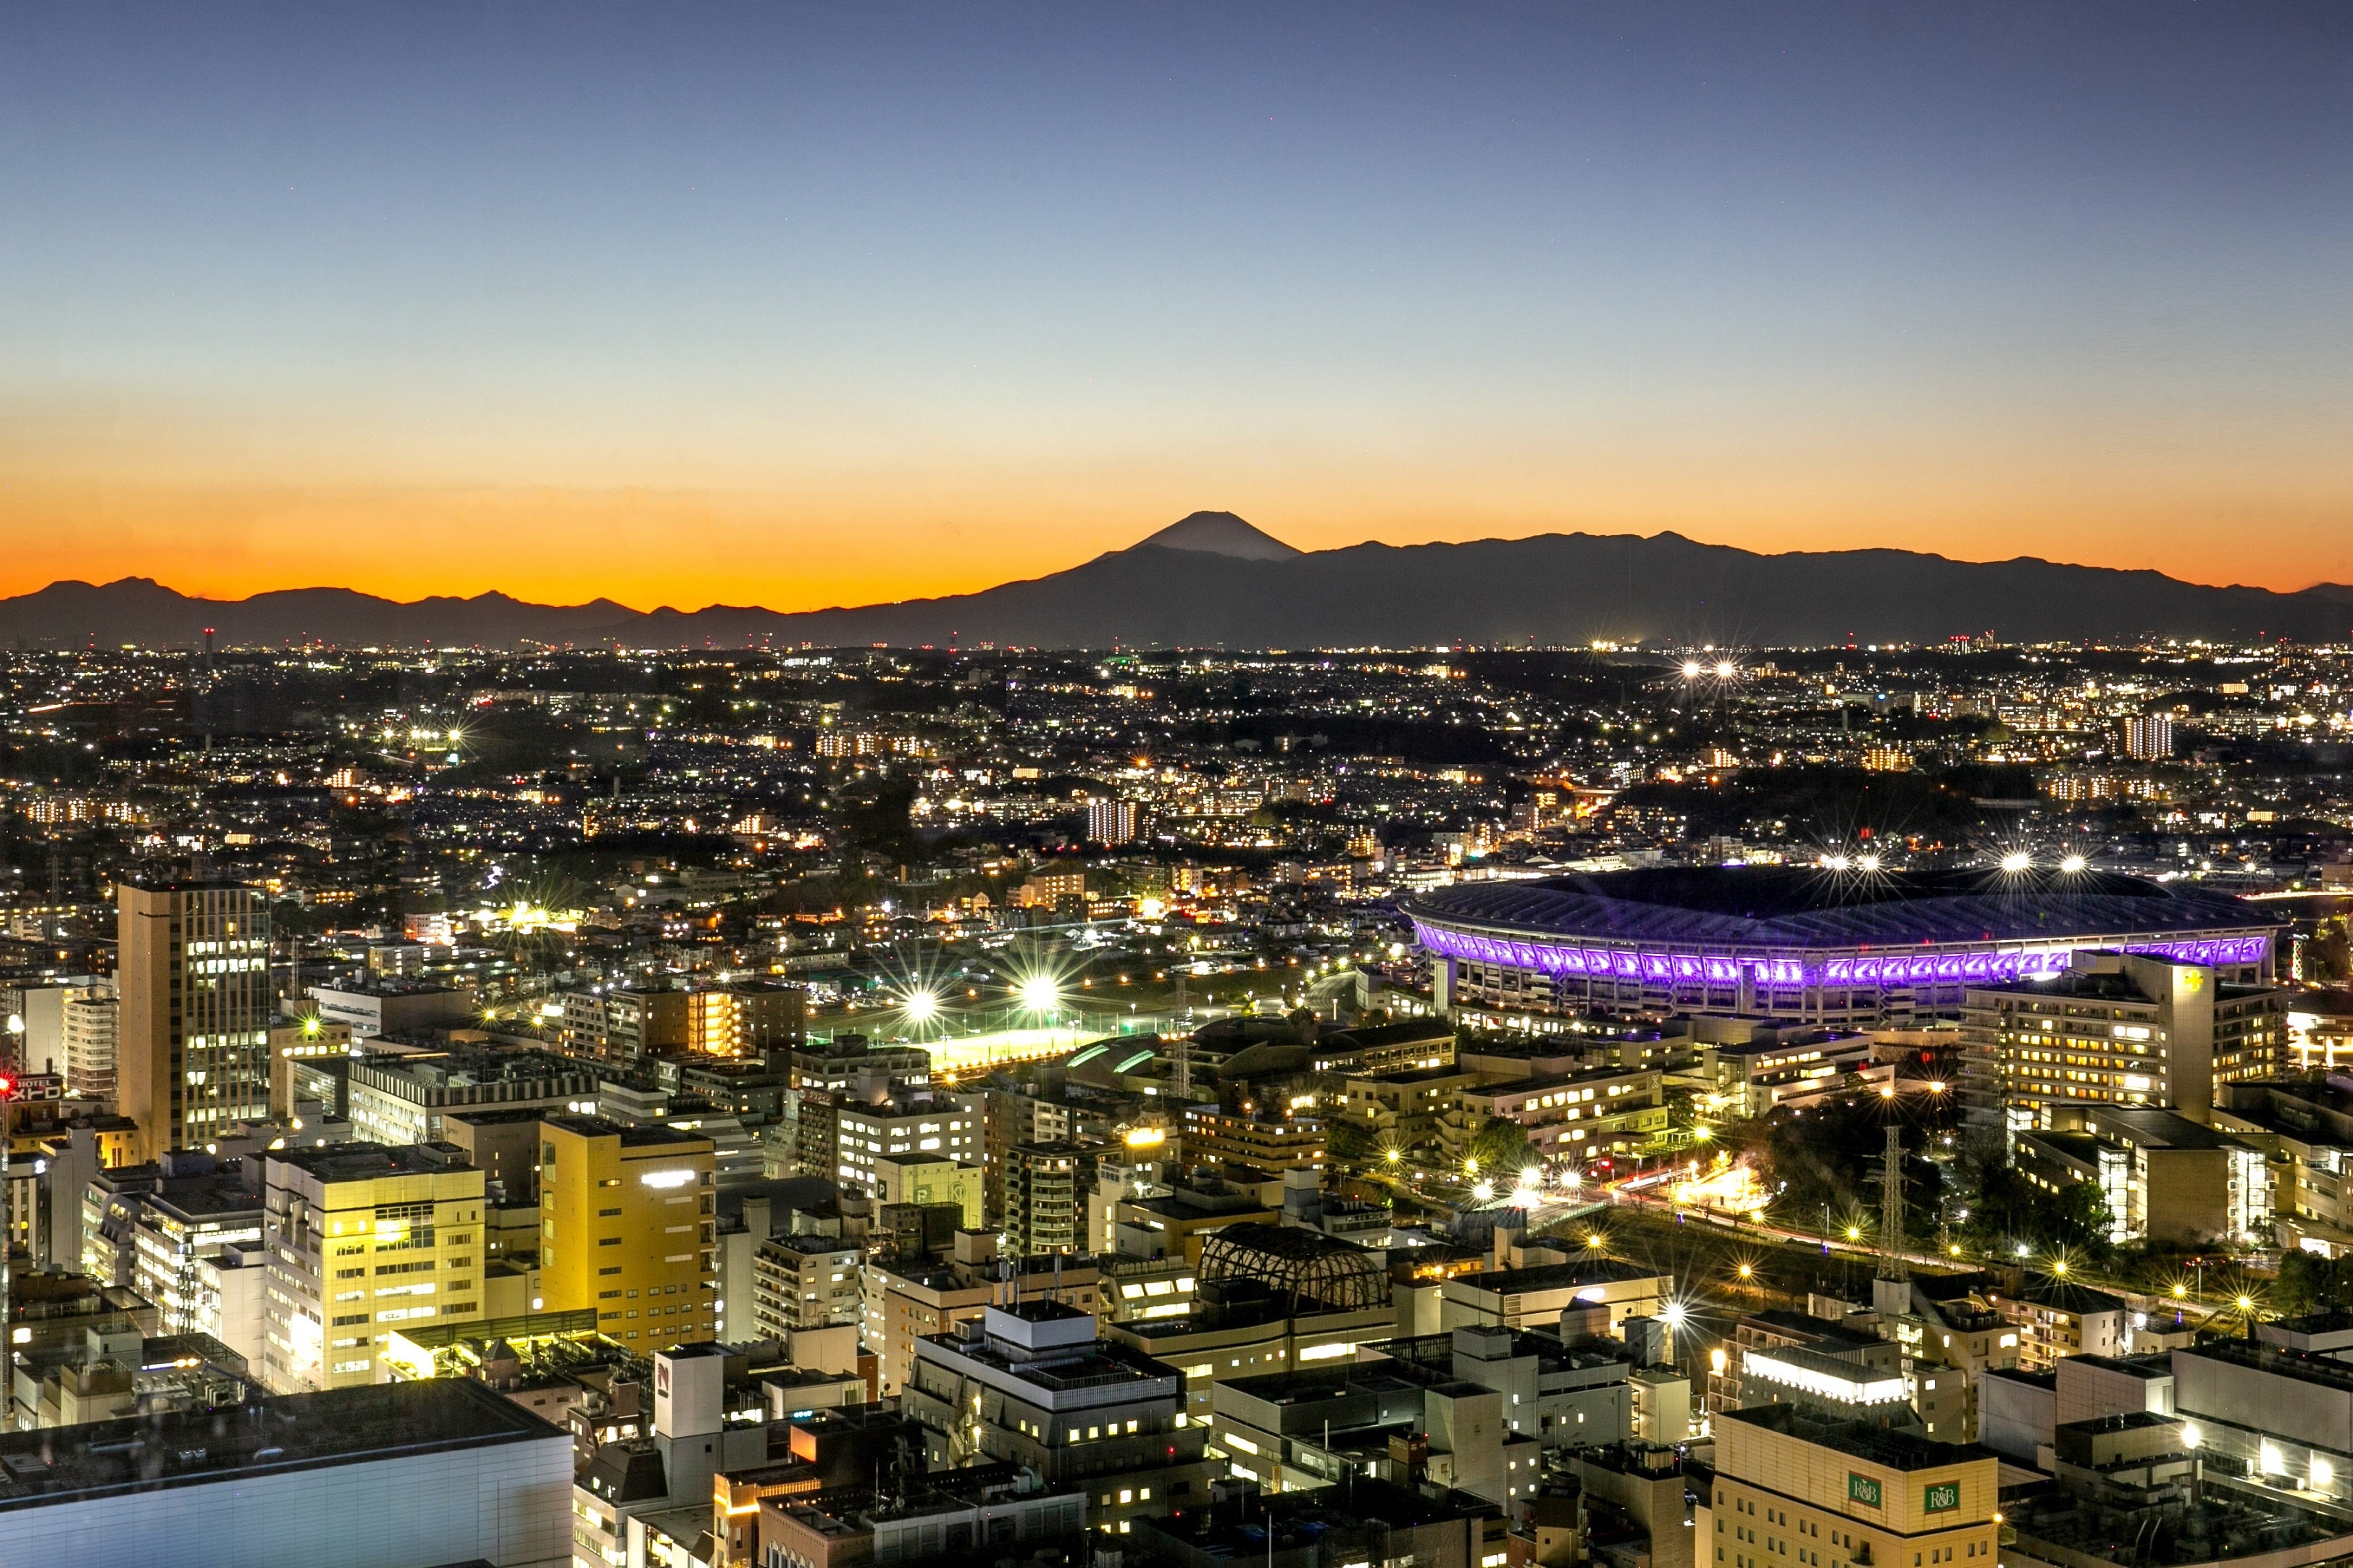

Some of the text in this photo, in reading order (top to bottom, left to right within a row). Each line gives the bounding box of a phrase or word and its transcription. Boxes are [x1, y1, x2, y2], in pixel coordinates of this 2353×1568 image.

[9, 1086, 61, 1102] メトロ
[879, 1184, 885, 1194] P
[917, 1190, 927, 1201] P
[1410, 1442, 1426, 1451] 石川
[1855, 1480, 1877, 1502] R&B
[1931, 1488, 1954, 1508] R&B
